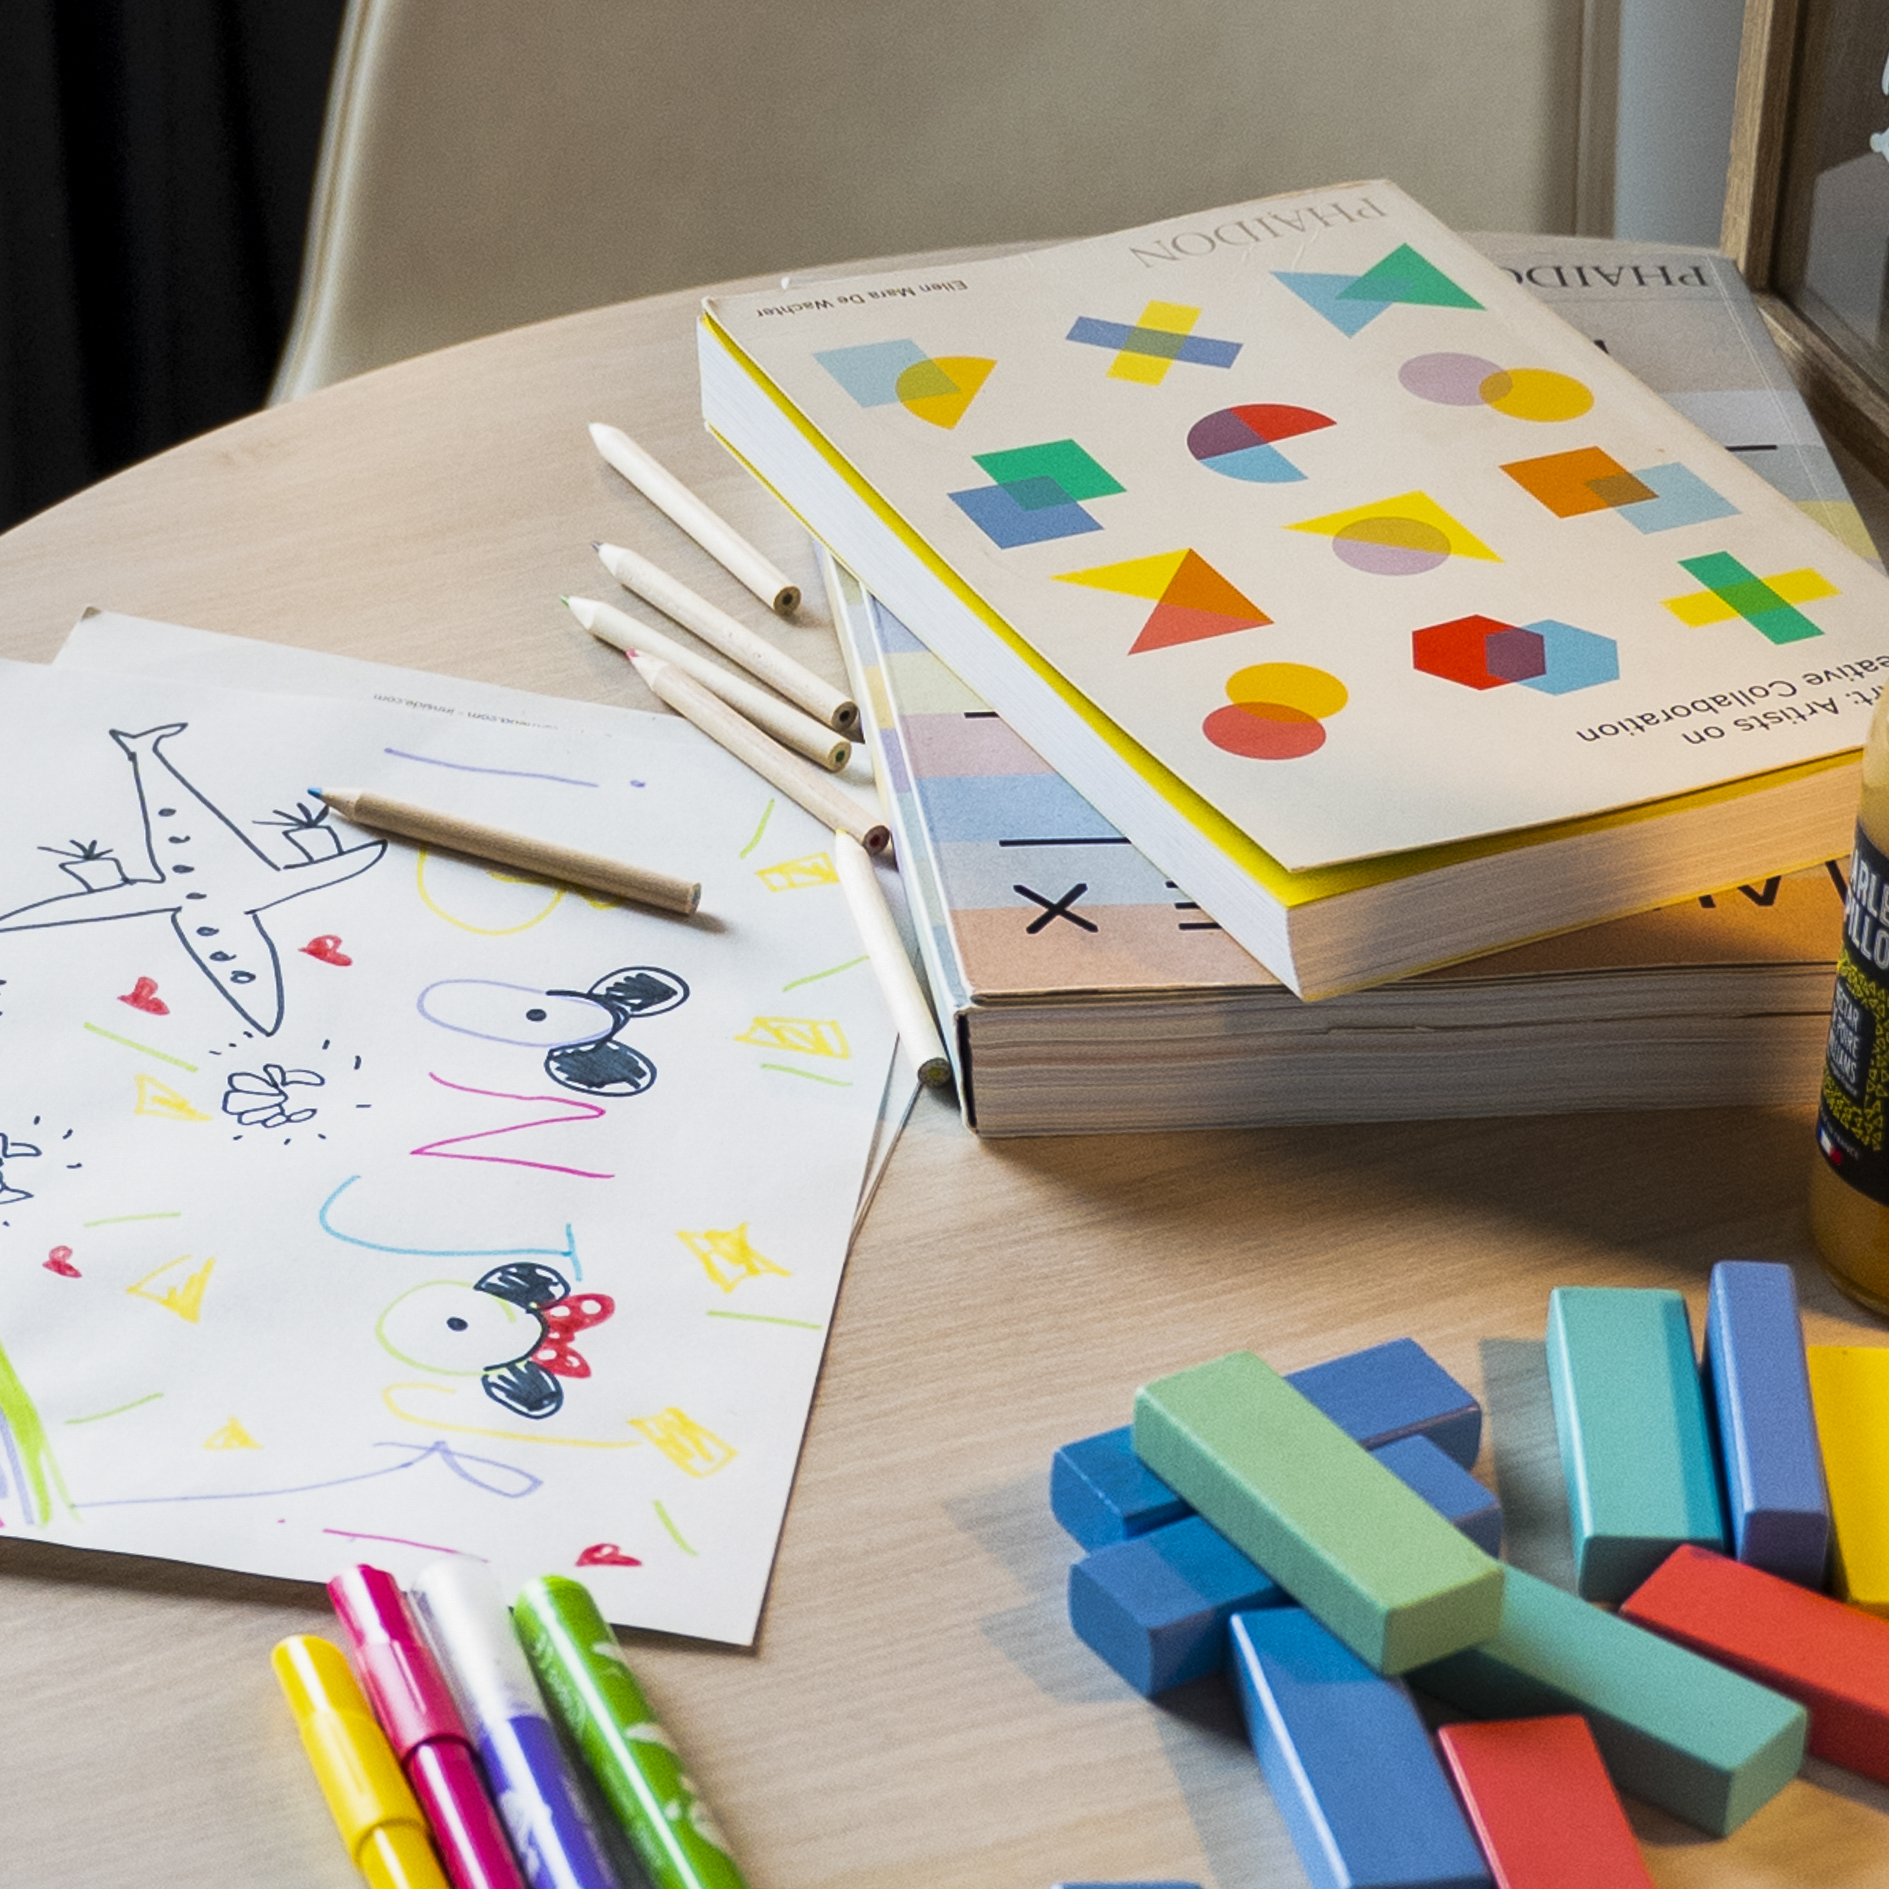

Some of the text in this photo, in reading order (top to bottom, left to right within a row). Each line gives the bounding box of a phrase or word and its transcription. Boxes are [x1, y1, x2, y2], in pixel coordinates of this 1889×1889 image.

[1129, 197, 1387, 269] PHAIDON
[1499, 265, 1709, 288] PHAID
[755, 279, 969, 319] Ellen Mara De Wachter
[1575, 654, 1889, 743] eative Collaboration
[1732, 696, 1840, 734] Artists
[1680, 725, 1726, 747] on
